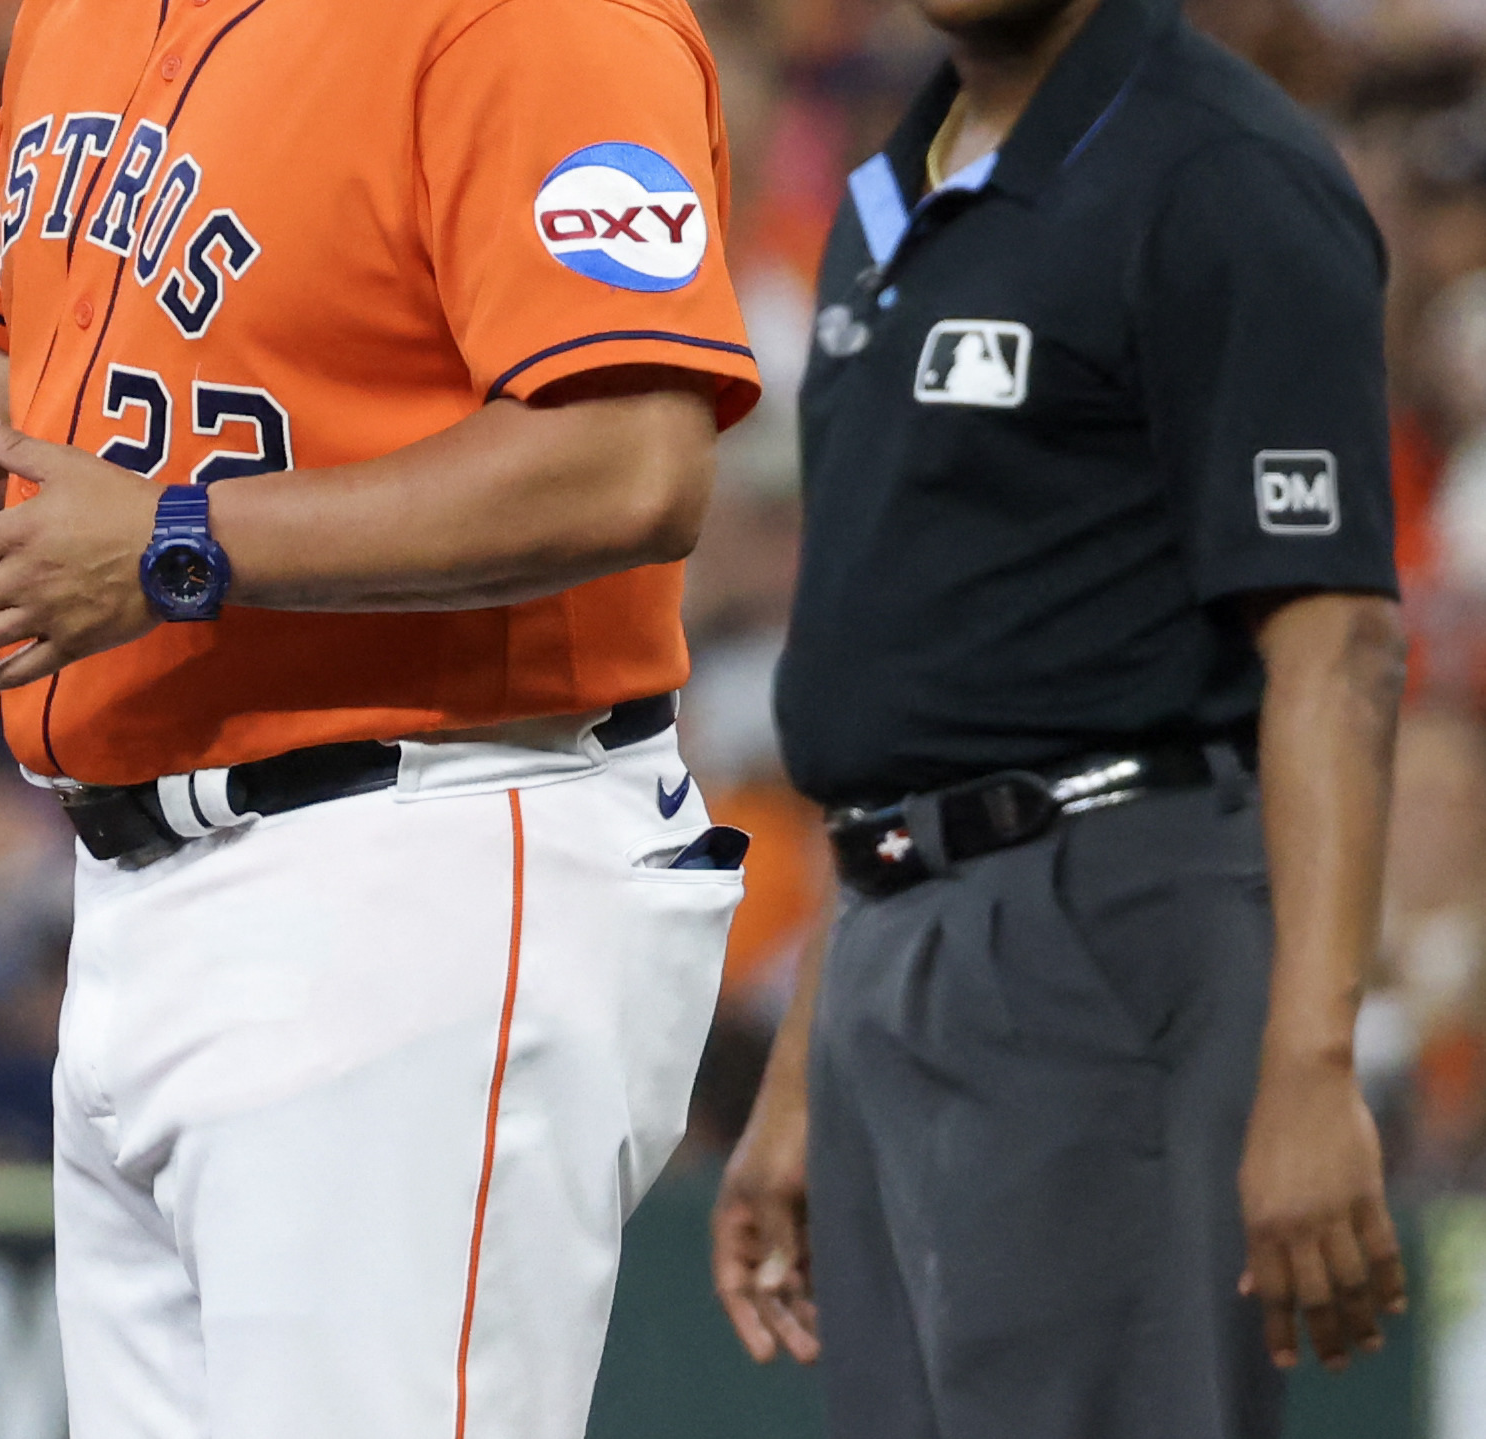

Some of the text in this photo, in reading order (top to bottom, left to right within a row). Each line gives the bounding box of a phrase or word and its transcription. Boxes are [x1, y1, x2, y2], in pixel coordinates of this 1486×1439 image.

[539, 202, 698, 244] OXY
[96, 362, 294, 486] 22
[1260, 470, 1331, 513] DM
